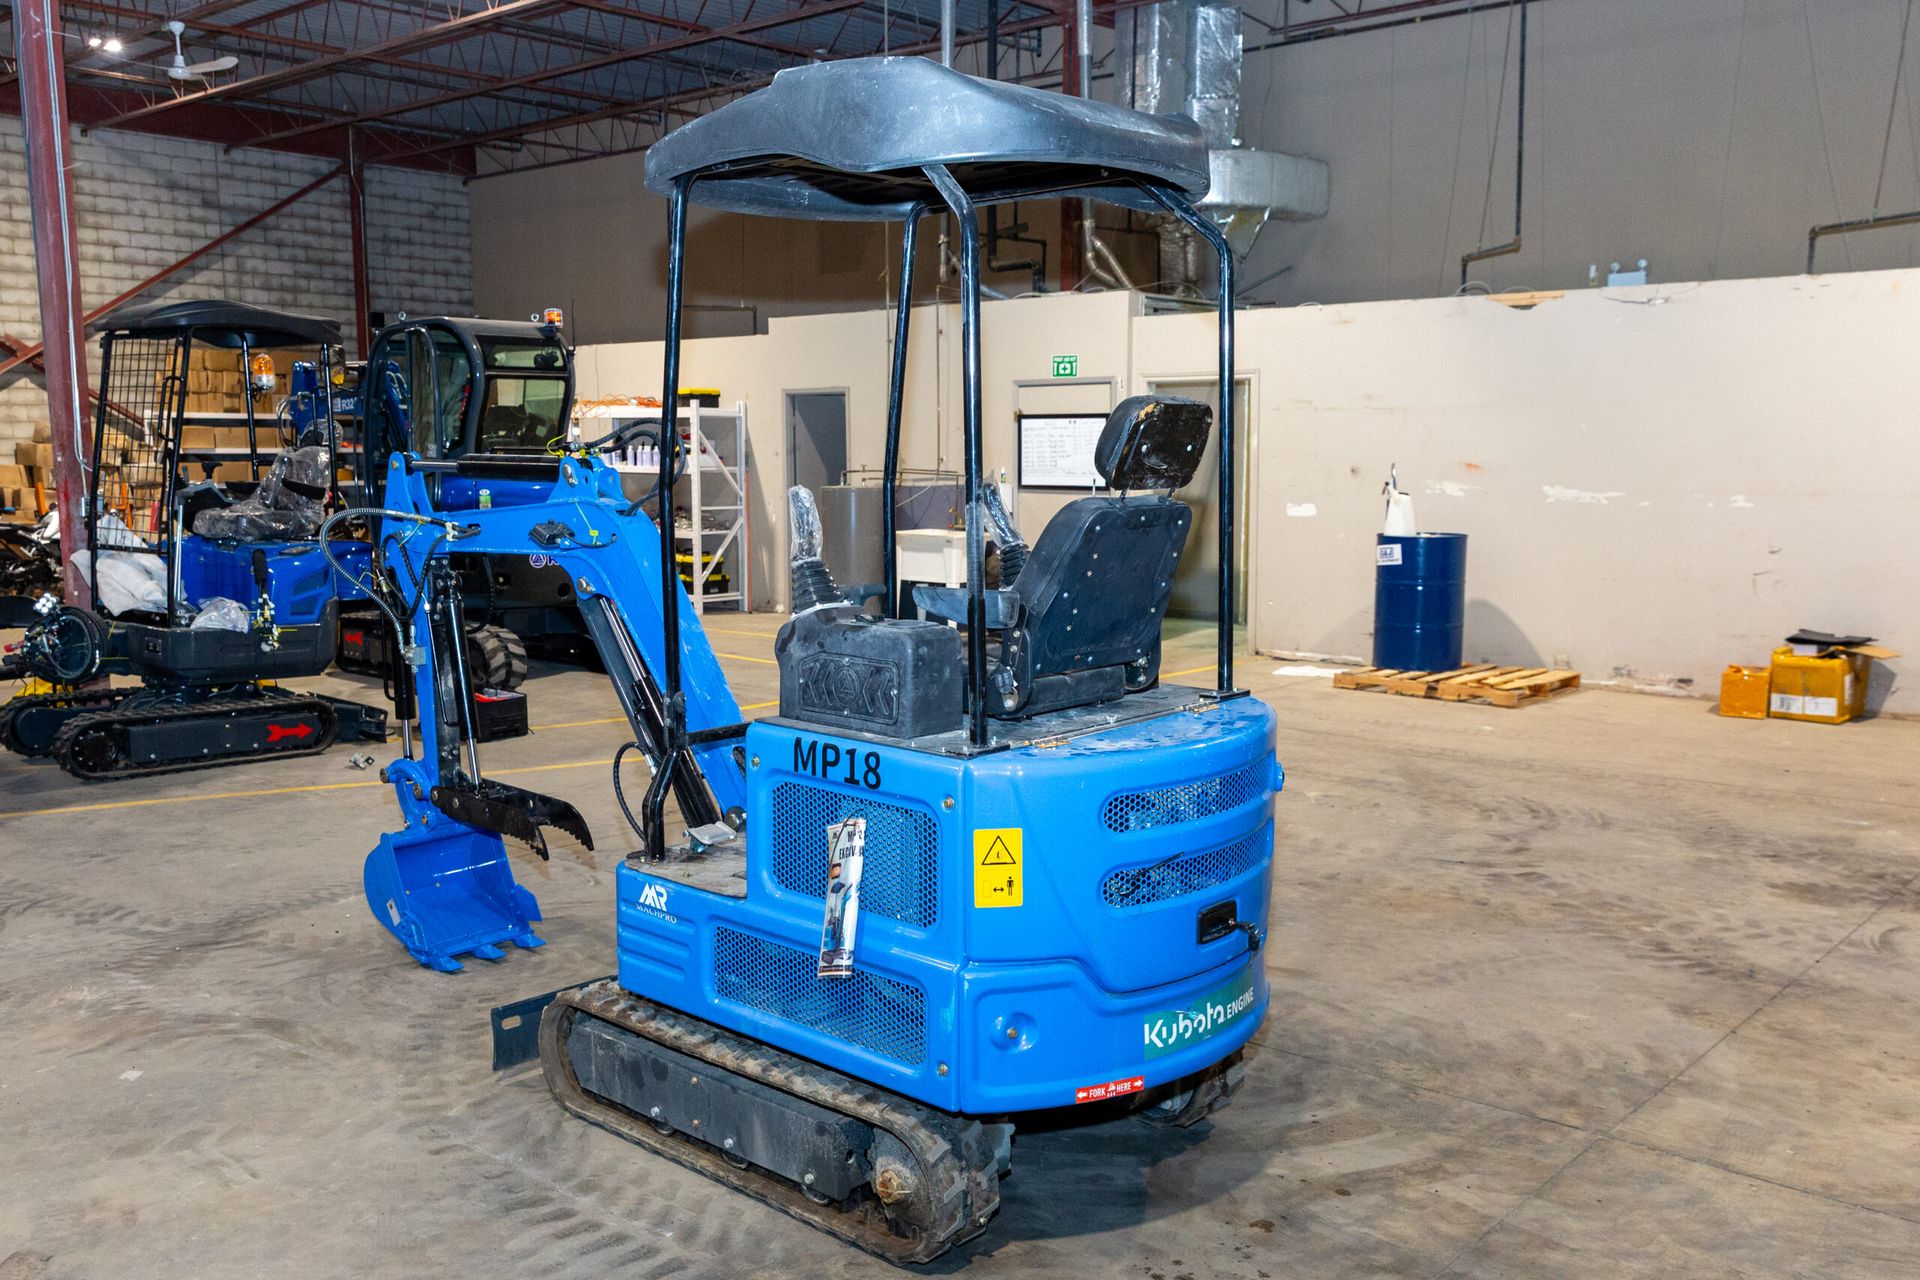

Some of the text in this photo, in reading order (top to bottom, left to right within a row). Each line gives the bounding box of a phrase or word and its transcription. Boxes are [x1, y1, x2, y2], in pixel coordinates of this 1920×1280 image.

[793, 736, 882, 790] MP18
[635, 903, 678, 924] MACHPRO
[1143, 986, 1254, 1048] Kubota ENGINE
[1089, 1081, 1132, 1098] FORK HERE
